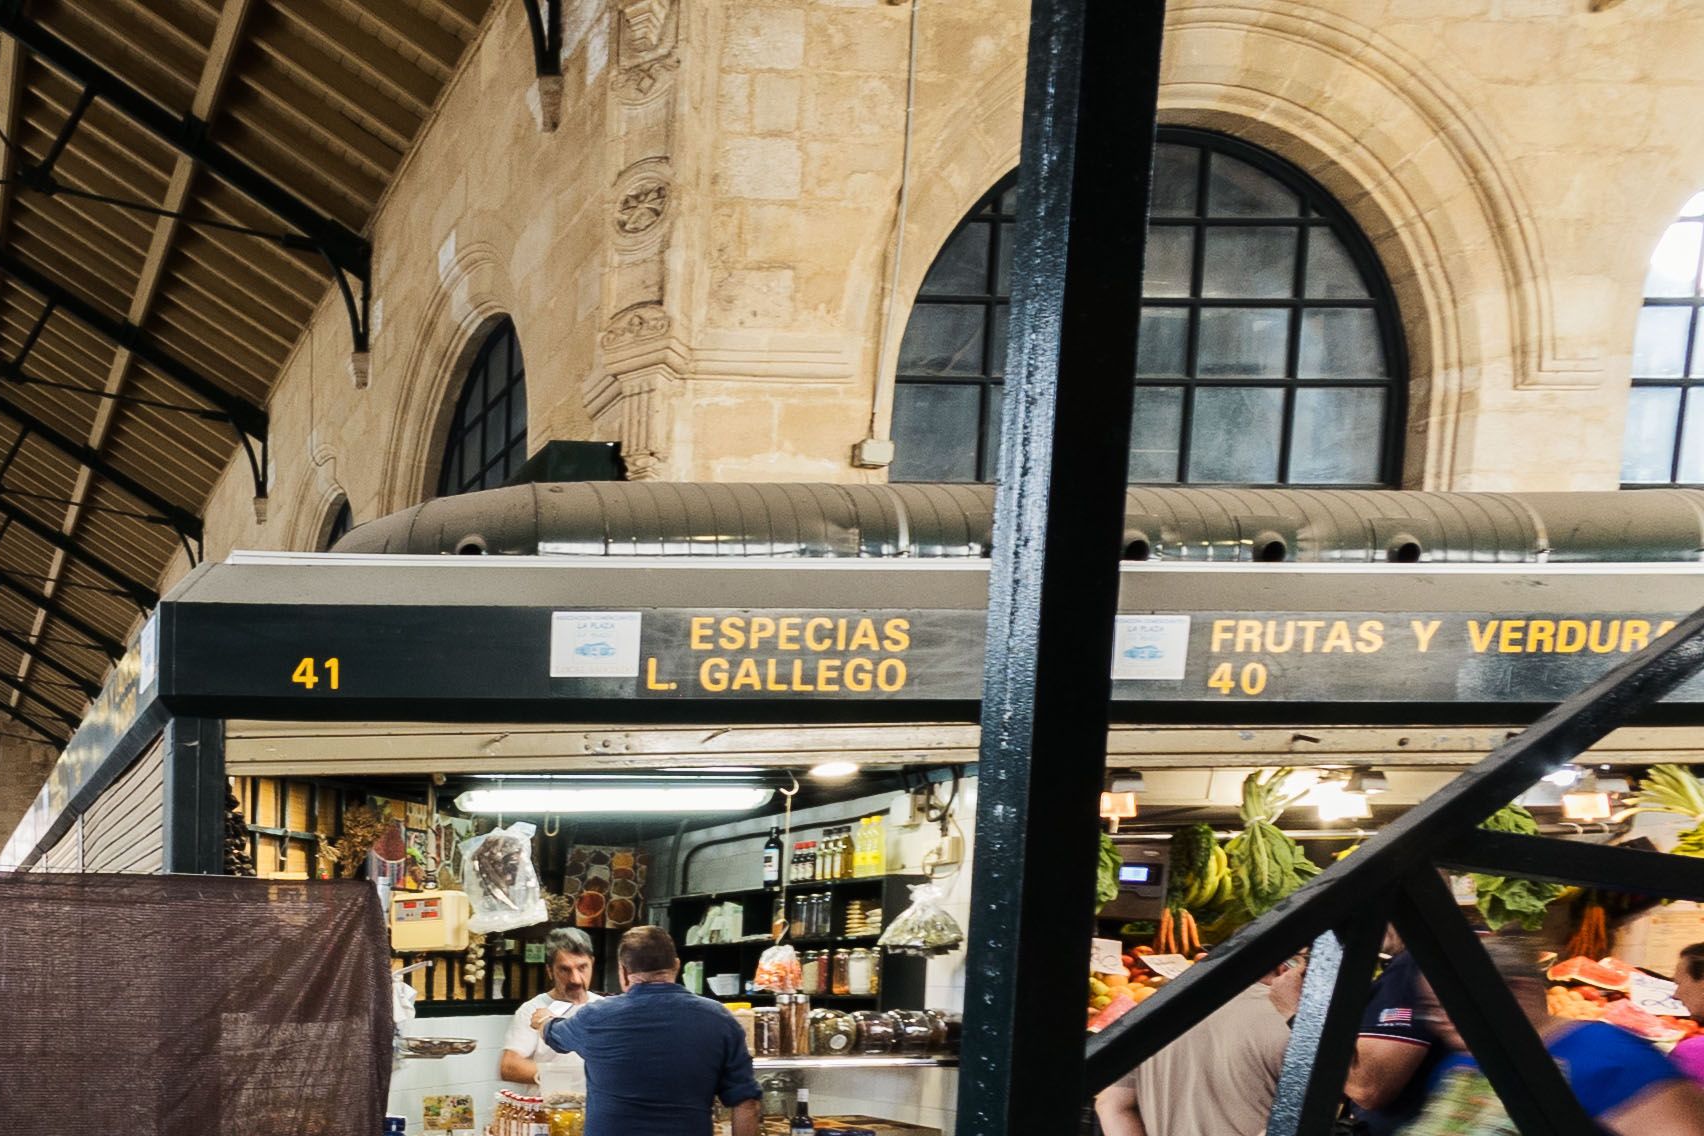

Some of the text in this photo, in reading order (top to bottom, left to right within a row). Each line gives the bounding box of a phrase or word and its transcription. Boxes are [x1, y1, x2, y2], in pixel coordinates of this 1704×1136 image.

[690, 616, 912, 652] ESPECIAS
[1210, 619, 1385, 652] FRUTAS
[1410, 619, 1442, 652] Y
[291, 656, 341, 691] 41
[646, 656, 908, 693] L. GALLEGO
[1207, 663, 1268, 696] 40
